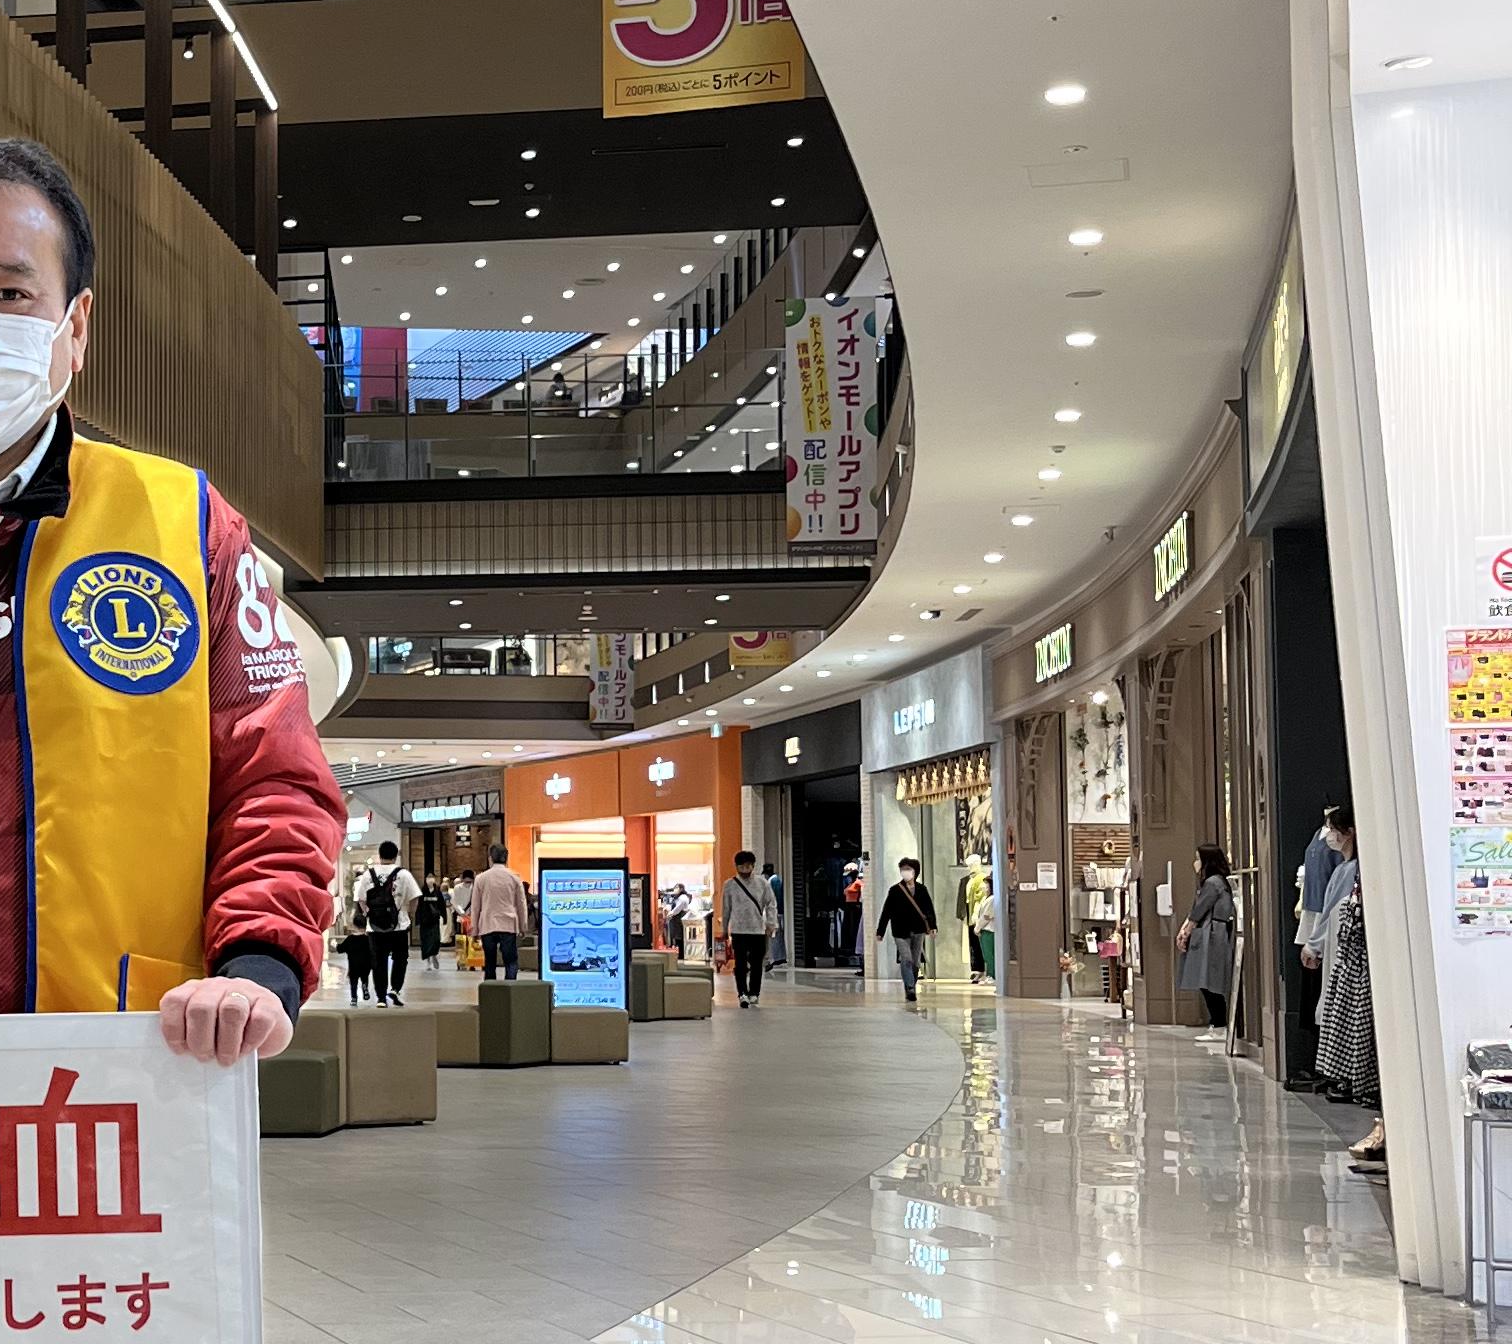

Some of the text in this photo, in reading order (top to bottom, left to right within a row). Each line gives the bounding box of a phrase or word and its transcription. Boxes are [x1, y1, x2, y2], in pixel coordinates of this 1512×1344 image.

[837, 308, 862, 535] イオンモールアプリ
[82, 567, 157, 592] LIONS
[108, 598, 147, 638] L
[94, 648, 168, 671] INTERNATIONAL
